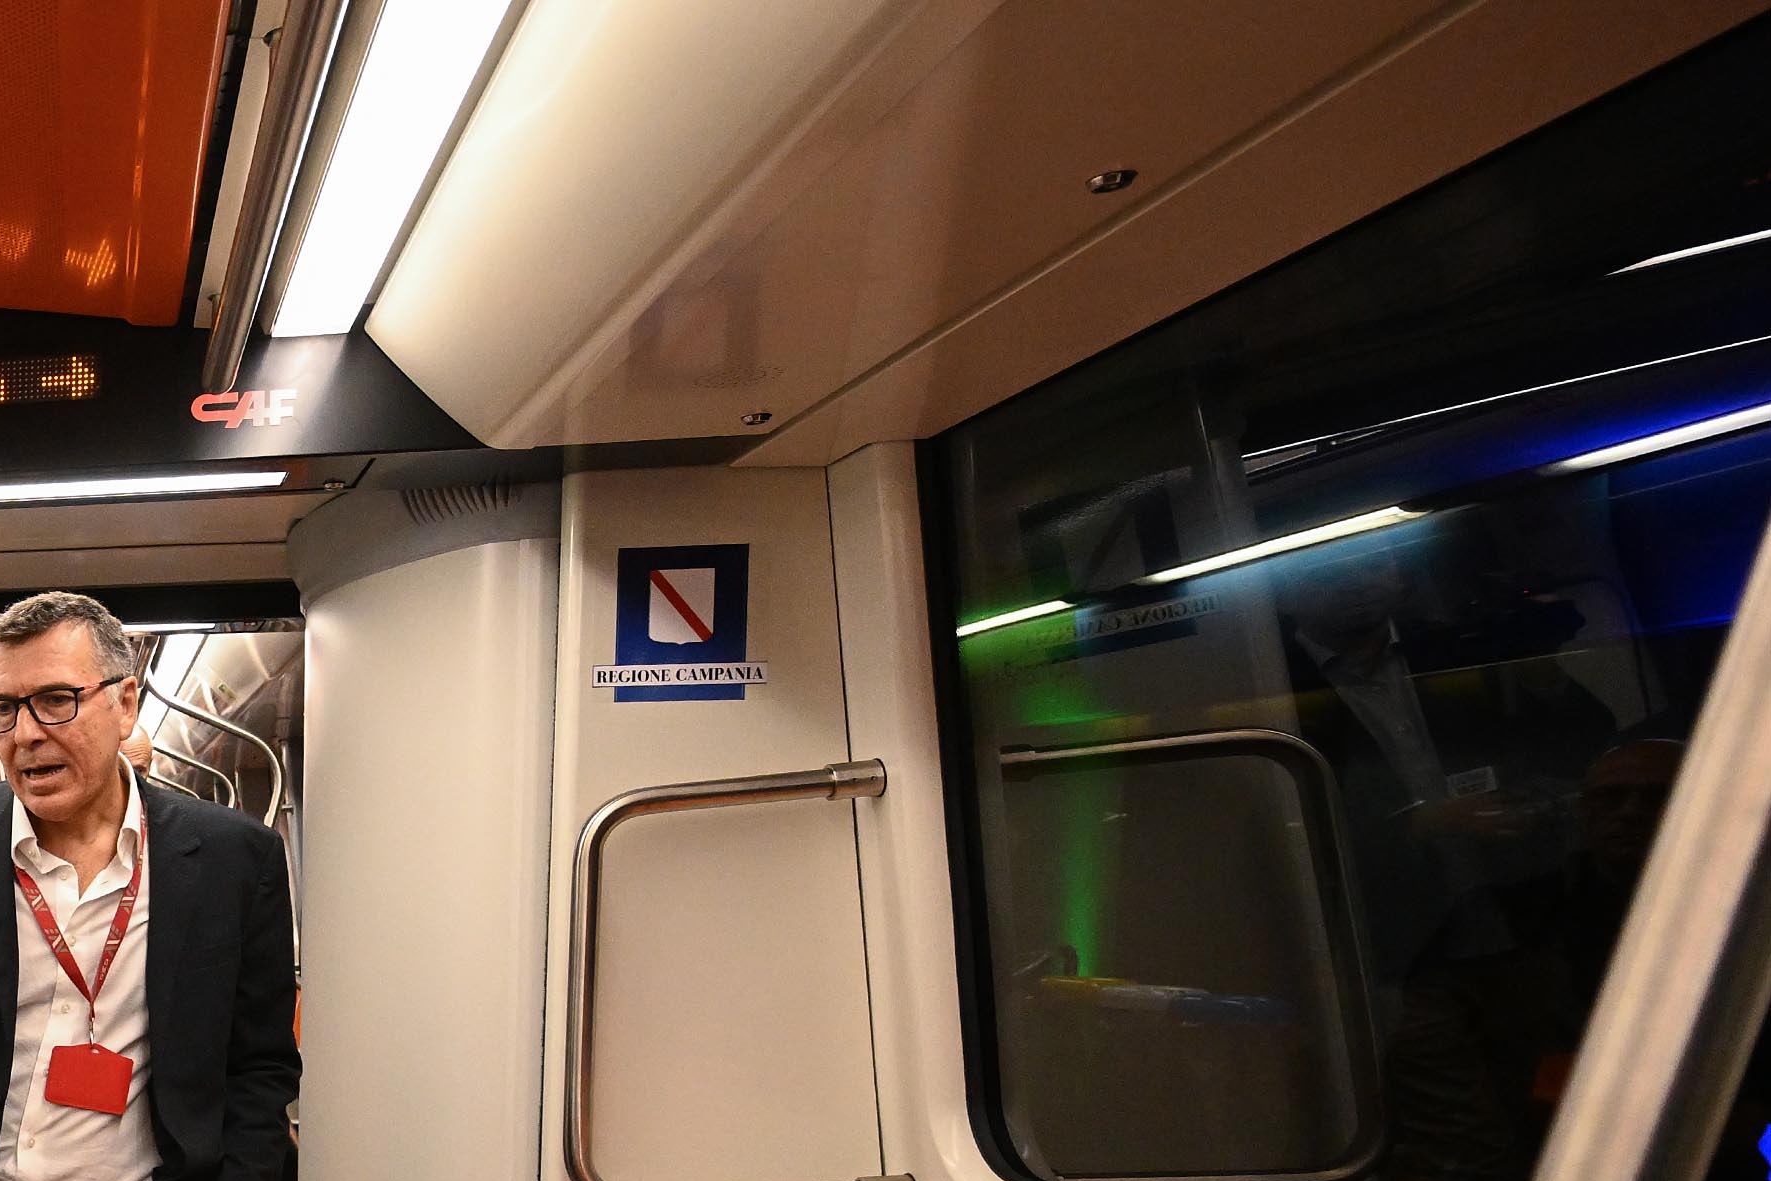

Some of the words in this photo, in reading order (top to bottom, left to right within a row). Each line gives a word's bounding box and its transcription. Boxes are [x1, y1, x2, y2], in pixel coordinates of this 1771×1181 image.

[191, 388, 298, 429] CAF
[596, 668, 671, 684] REGIONE
[675, 665, 765, 682] CAMPANIA
